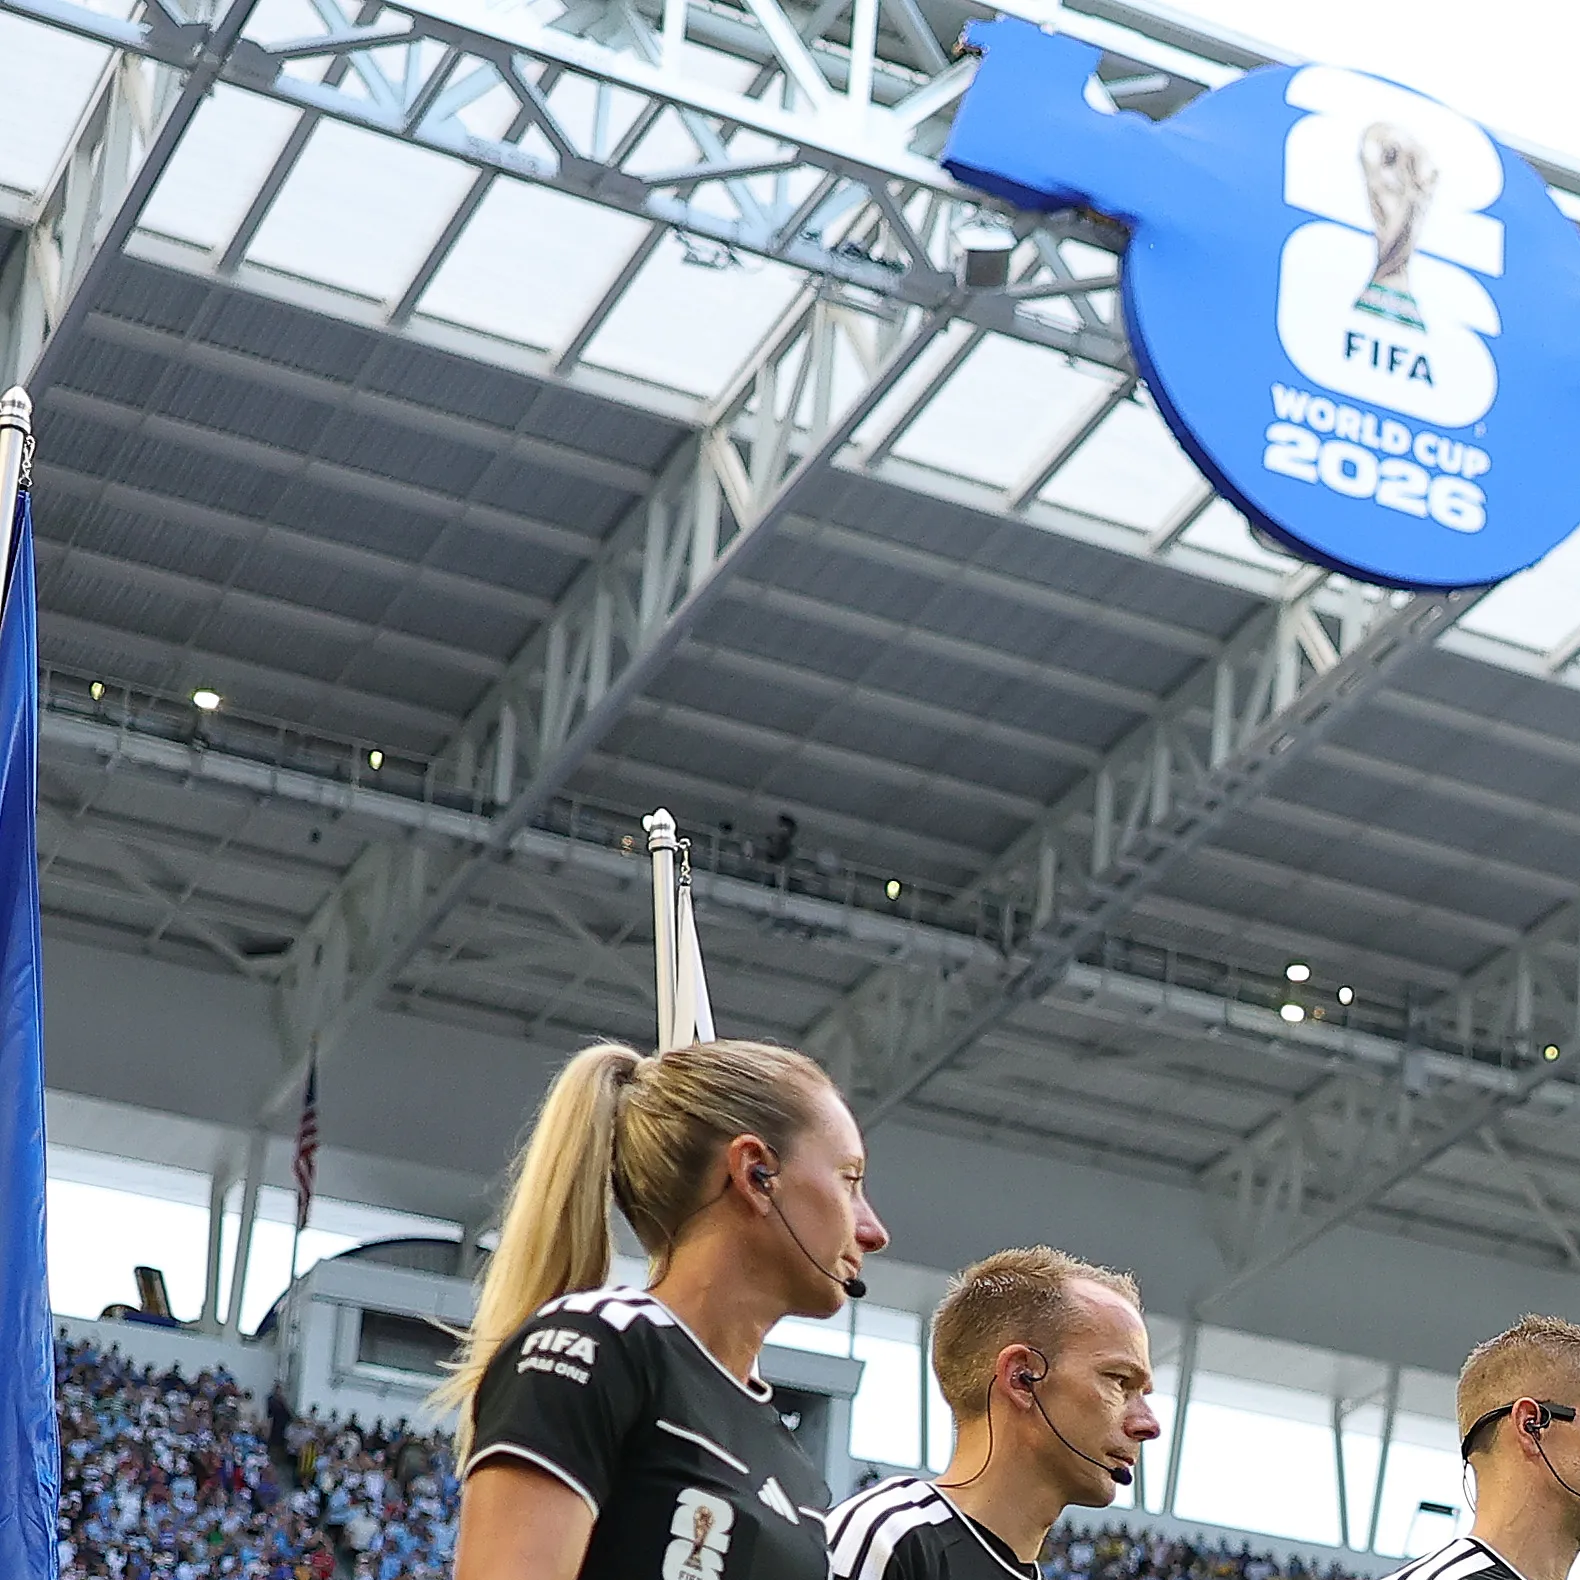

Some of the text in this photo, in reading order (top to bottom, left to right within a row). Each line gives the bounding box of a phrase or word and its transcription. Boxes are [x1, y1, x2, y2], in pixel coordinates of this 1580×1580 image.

[1341, 330, 1436, 388] FIFA
[1270, 381, 1492, 479] WORLD CUP
[1263, 421, 1488, 534] 2026
[521, 1329, 597, 1365] FIFA
